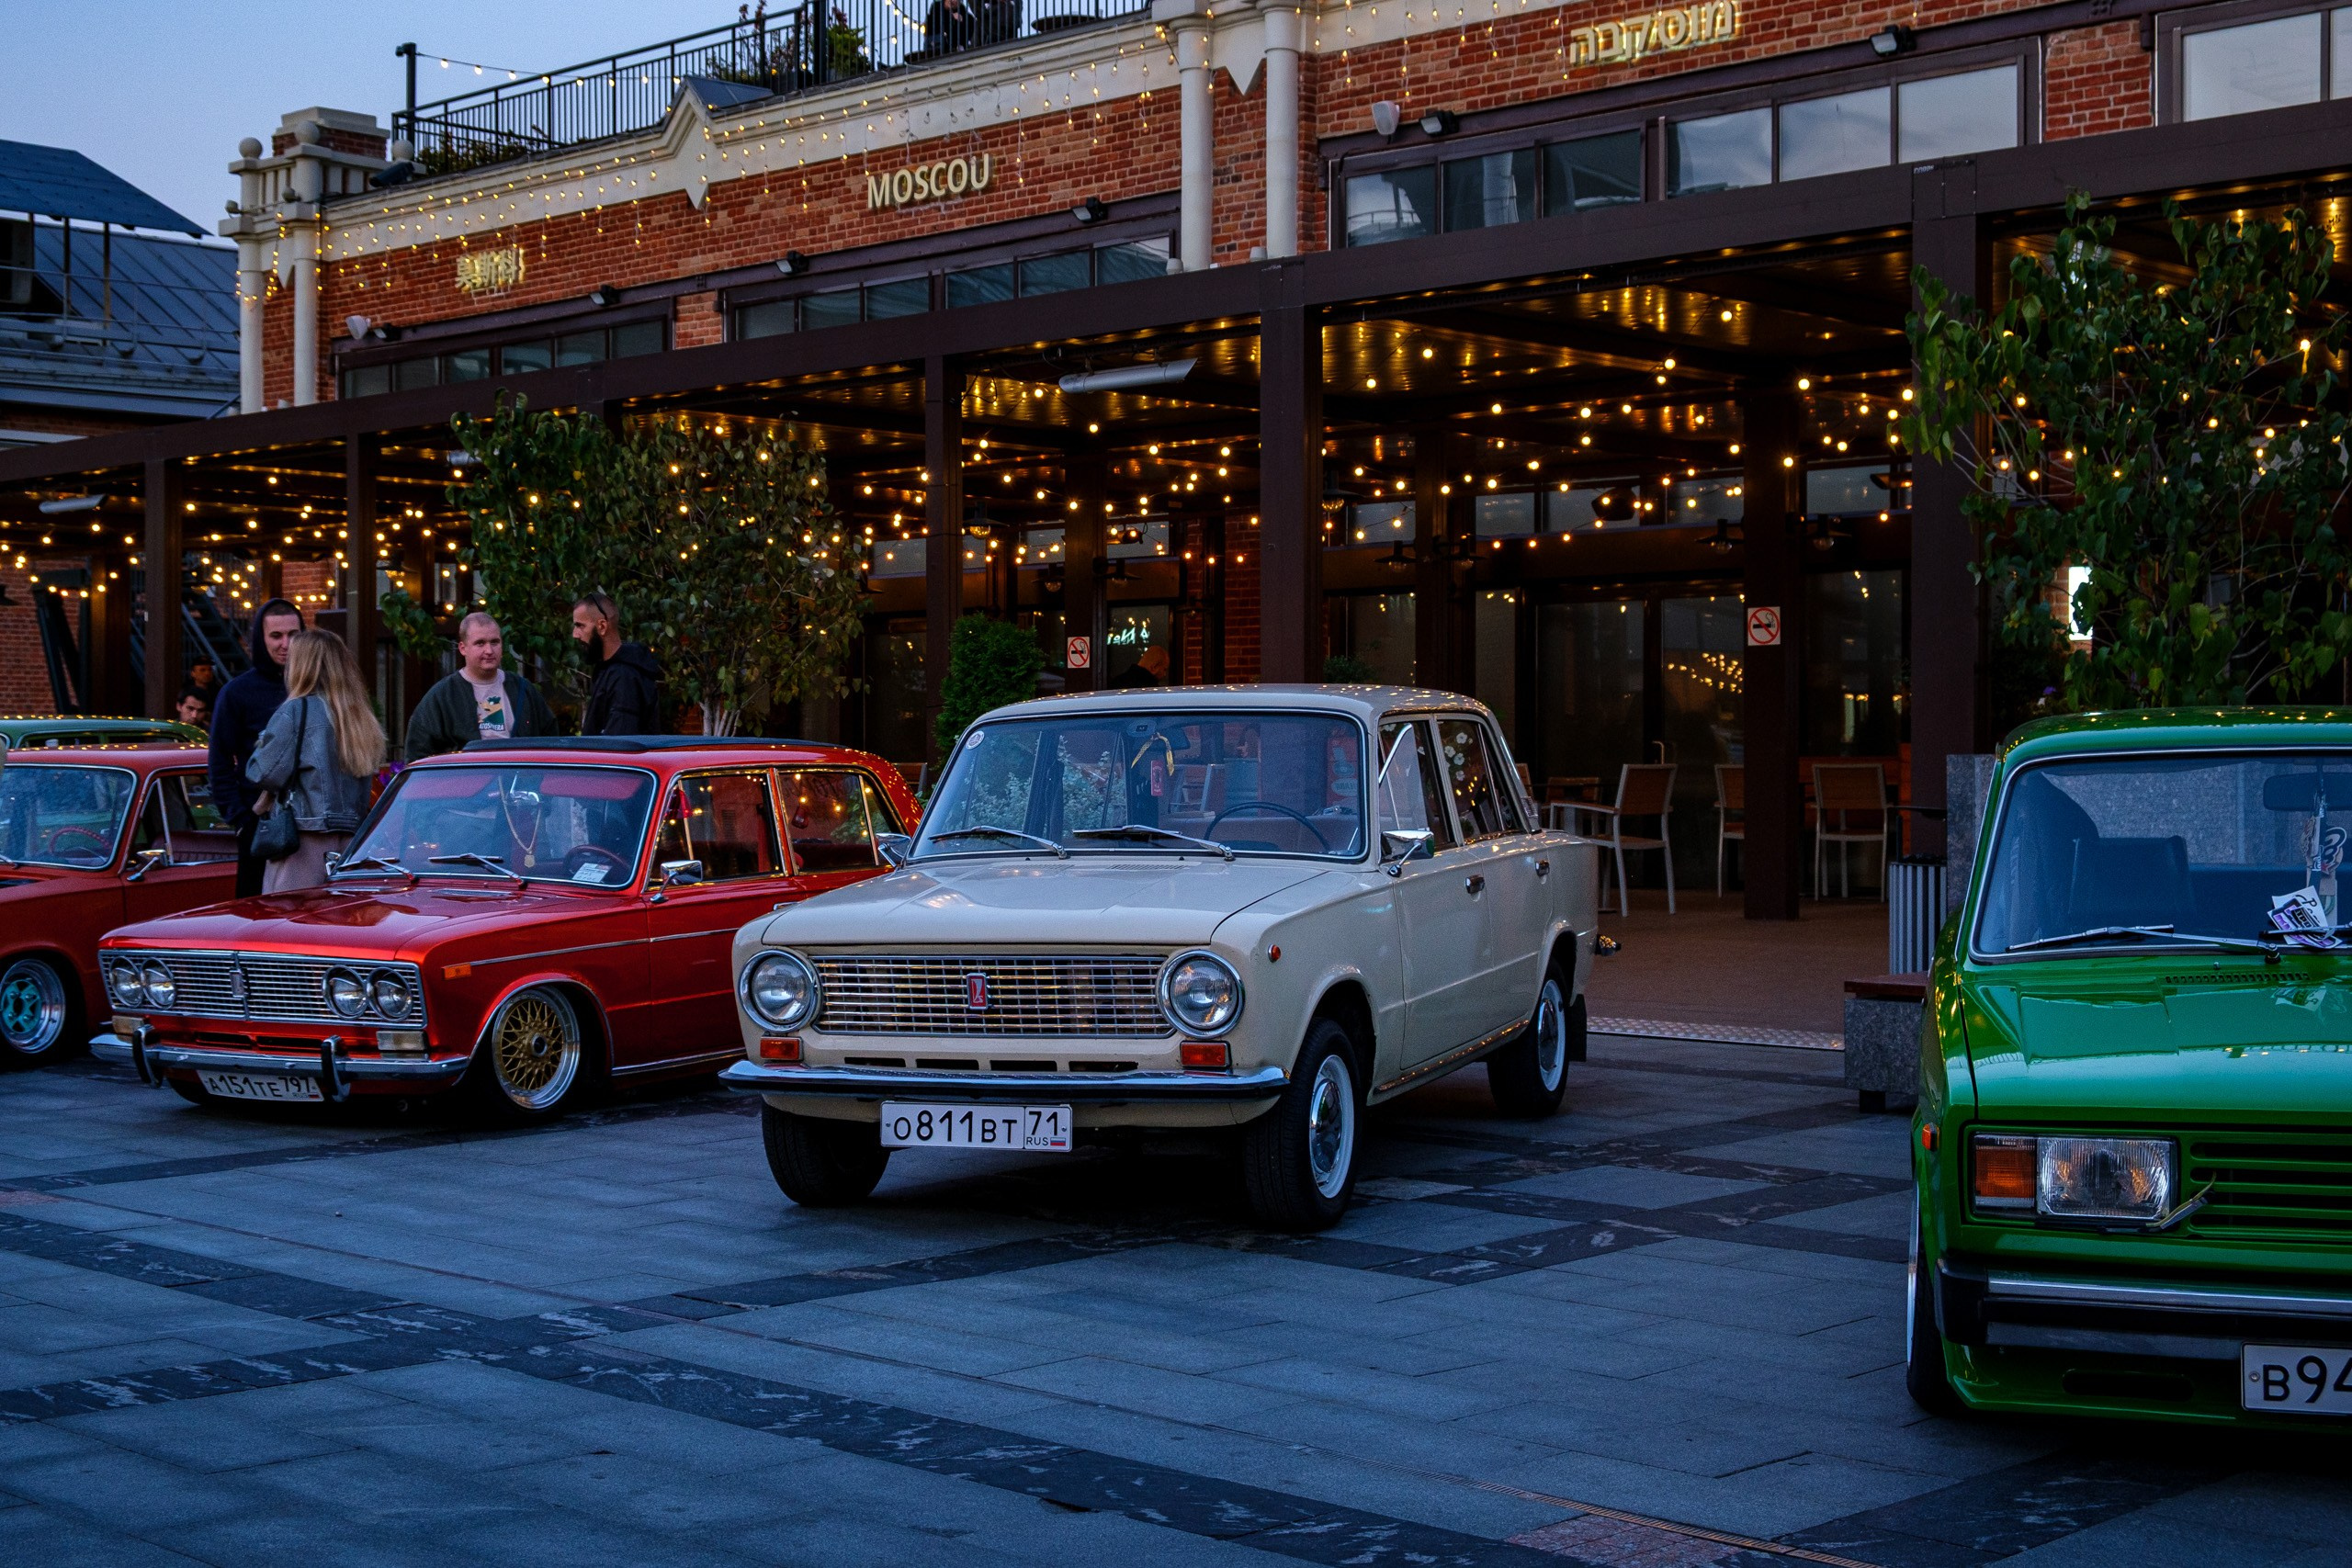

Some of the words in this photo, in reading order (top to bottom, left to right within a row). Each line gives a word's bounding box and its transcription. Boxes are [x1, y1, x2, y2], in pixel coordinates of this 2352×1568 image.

[1569, 0, 1734, 64] מוסקבה
[867, 152, 990, 209] MOSCOU
[455, 249, 519, 290] 莫斯科
[277, 1077, 311, 1093] 797
[1028, 1111, 1058, 1136] 71
[1026, 1136, 1049, 1146] RUS
